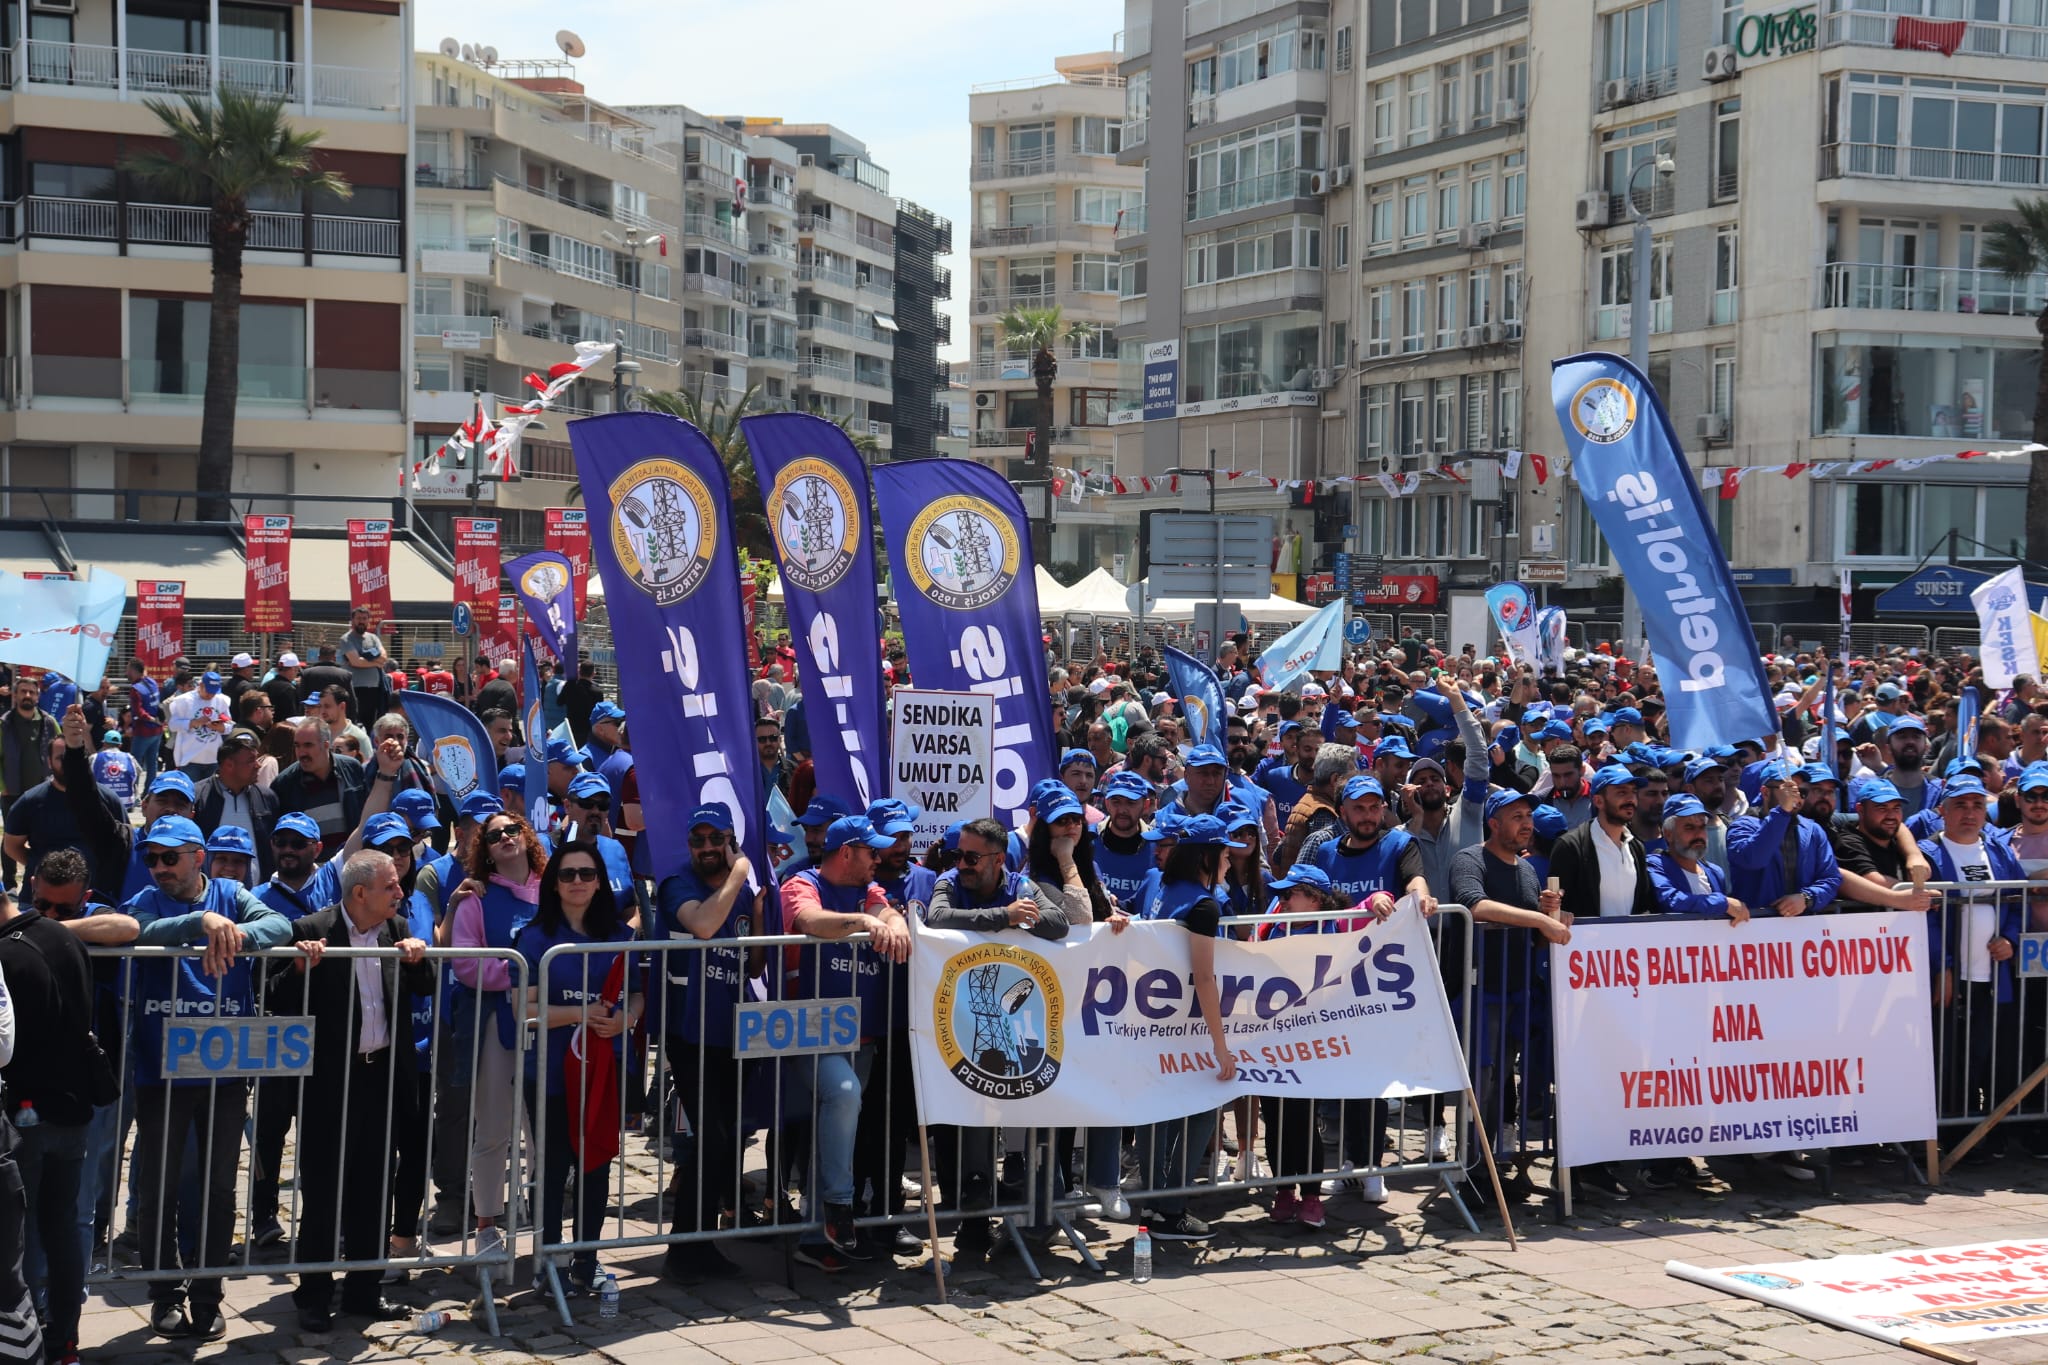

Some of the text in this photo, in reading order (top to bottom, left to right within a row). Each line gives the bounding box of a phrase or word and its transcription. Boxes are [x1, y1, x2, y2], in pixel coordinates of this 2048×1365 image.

[1736, 8, 1817, 57] Olivos
[443, 486, 489, 494] ÜNİVEESİ
[265, 518, 287, 528] CHP
[564, 511, 584, 520] CHP
[367, 522, 387, 531] CHP
[474, 522, 495, 531] CHP
[248, 556, 266, 571] HAK
[254, 562, 282, 580] HUKUK
[351, 560, 369, 575] HAK
[258, 571, 288, 591] ADALET
[358, 566, 383, 584] HUKUK
[362, 574, 388, 594] ADALET
[157, 584, 179, 593] CHP
[474, 576, 498, 595] EMEK
[1915, 581, 1964, 595] SUNSET
[457, 606, 465, 622] P
[1353, 620, 1363, 634] P
[158, 640, 181, 660] EMEK
[902, 700, 983, 727] SENDİKA
[911, 733, 972, 756] VARSA
[899, 763, 984, 784] UMUT DA
[921, 792, 959, 812] VAR
[913, 823, 937, 835] OL-İŞ
[1102, 872, 1144, 891] ÖREV
[1568, 926, 1913, 998] SAVAŞ BALTALARINI GÖMDÜK
[145, 997, 241, 1015] petro-iş
[938, 948, 1059, 1056] TÜRKİYE PETROL KİMYA LASTİK İŞÇİLERİ SENDİKASI
[1105, 1021, 1148, 1041] Türkiye
[1150, 1022, 1187, 1038] Petrol
[1320, 1002, 1388, 1023] Sendikası
[1712, 1003, 1764, 1043] AMA
[1159, 1050, 1256, 1074] MANSA
[958, 1062, 1056, 1097] PETROL-İŞ 1950
[1237, 1067, 1302, 1085] 2021
[1619, 1056, 1865, 1109] YERİNİ UNUTMADIK !
[1629, 1110, 1859, 1147] RAVAGO ENPLAST İŞÇİLERİ
[1913, 1286, 2048, 1306] MÜC
